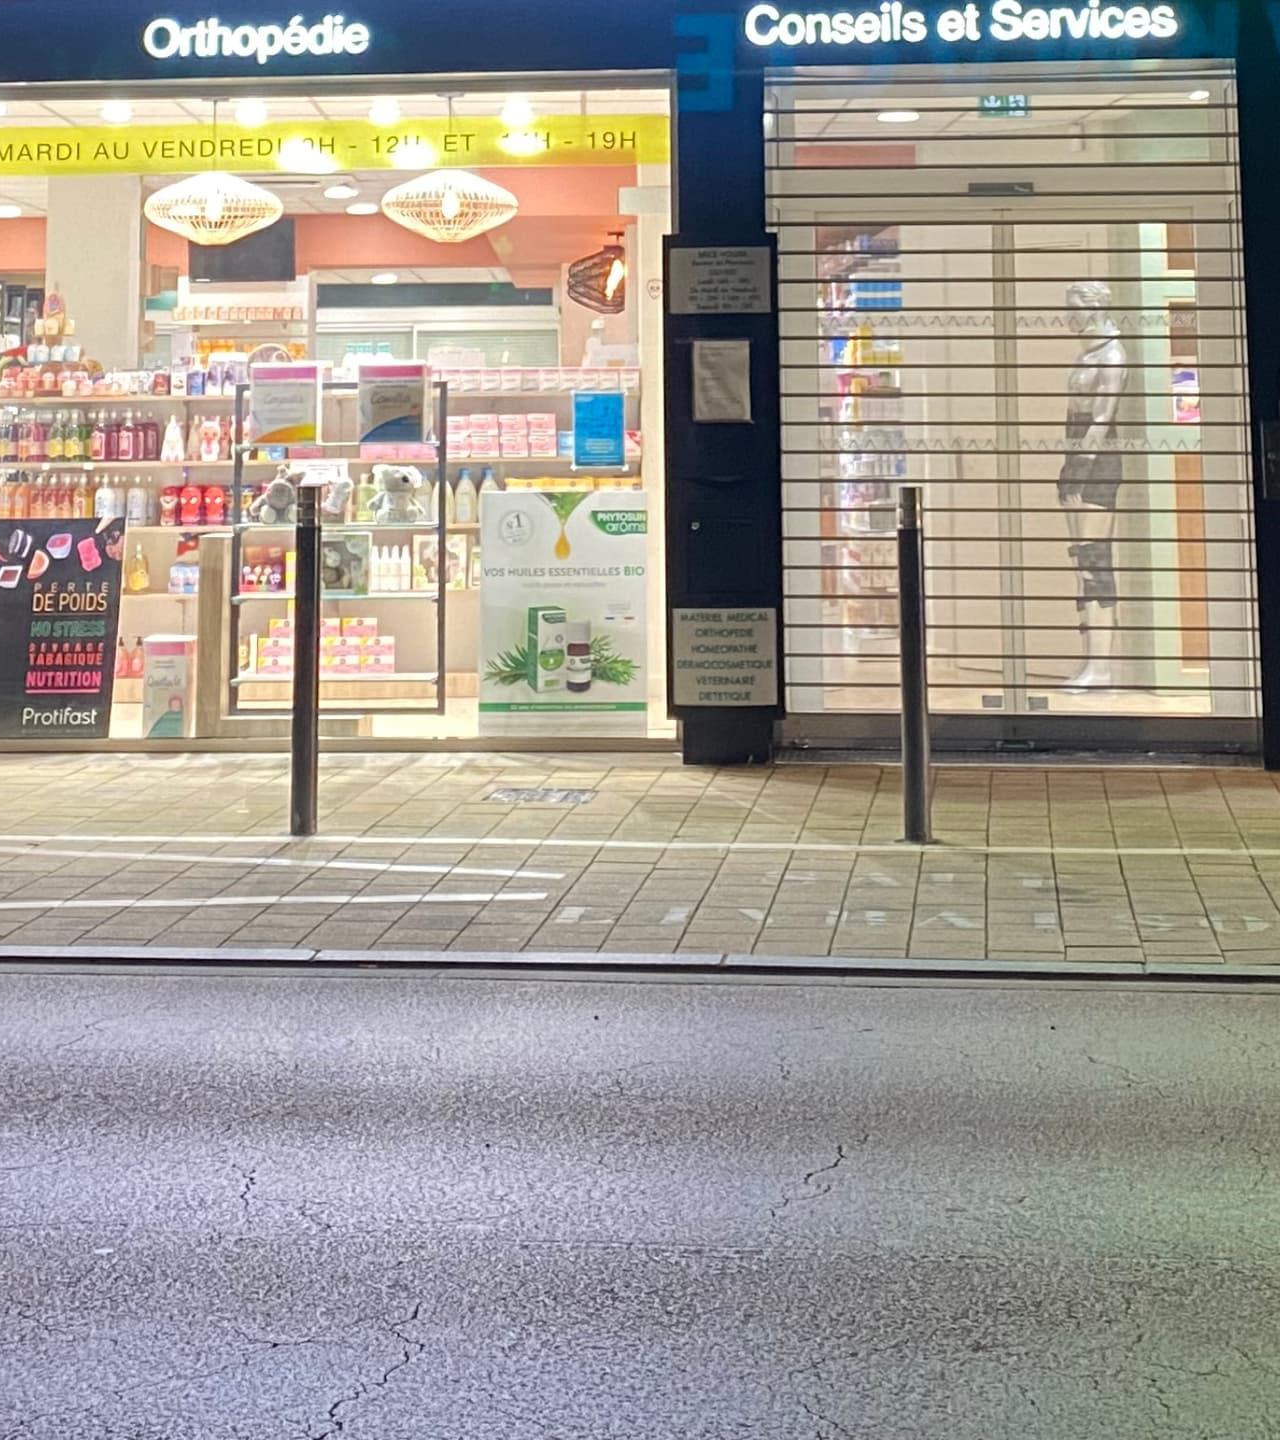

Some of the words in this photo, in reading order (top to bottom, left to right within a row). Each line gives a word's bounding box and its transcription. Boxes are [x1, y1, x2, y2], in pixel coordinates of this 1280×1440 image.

[744, 0, 927, 46] Conseils
[937, 3, 981, 42] et
[143, 14, 370, 59] Orthopédie
[93, 142, 130, 160] AU
[143, 138, 282, 159] VENDREDI
[443, 134, 476, 153] ET
[590, 131, 637, 150] 19H
[508, 567, 546, 577] HUILES
[548, 567, 621, 577] ESSENTIELLES
[623, 566, 645, 576] BIO
[34, 582, 110, 593] PERTE
[32, 593, 55, 612] DE
[59, 592, 108, 611] POIDS
[30, 621, 51, 637] NO
[52, 620, 106, 637] STRESS
[28, 652, 103, 666] TABAGIQUE
[25, 670, 102, 688] NUTRITION
[22, 707, 98, 725] Protifast
